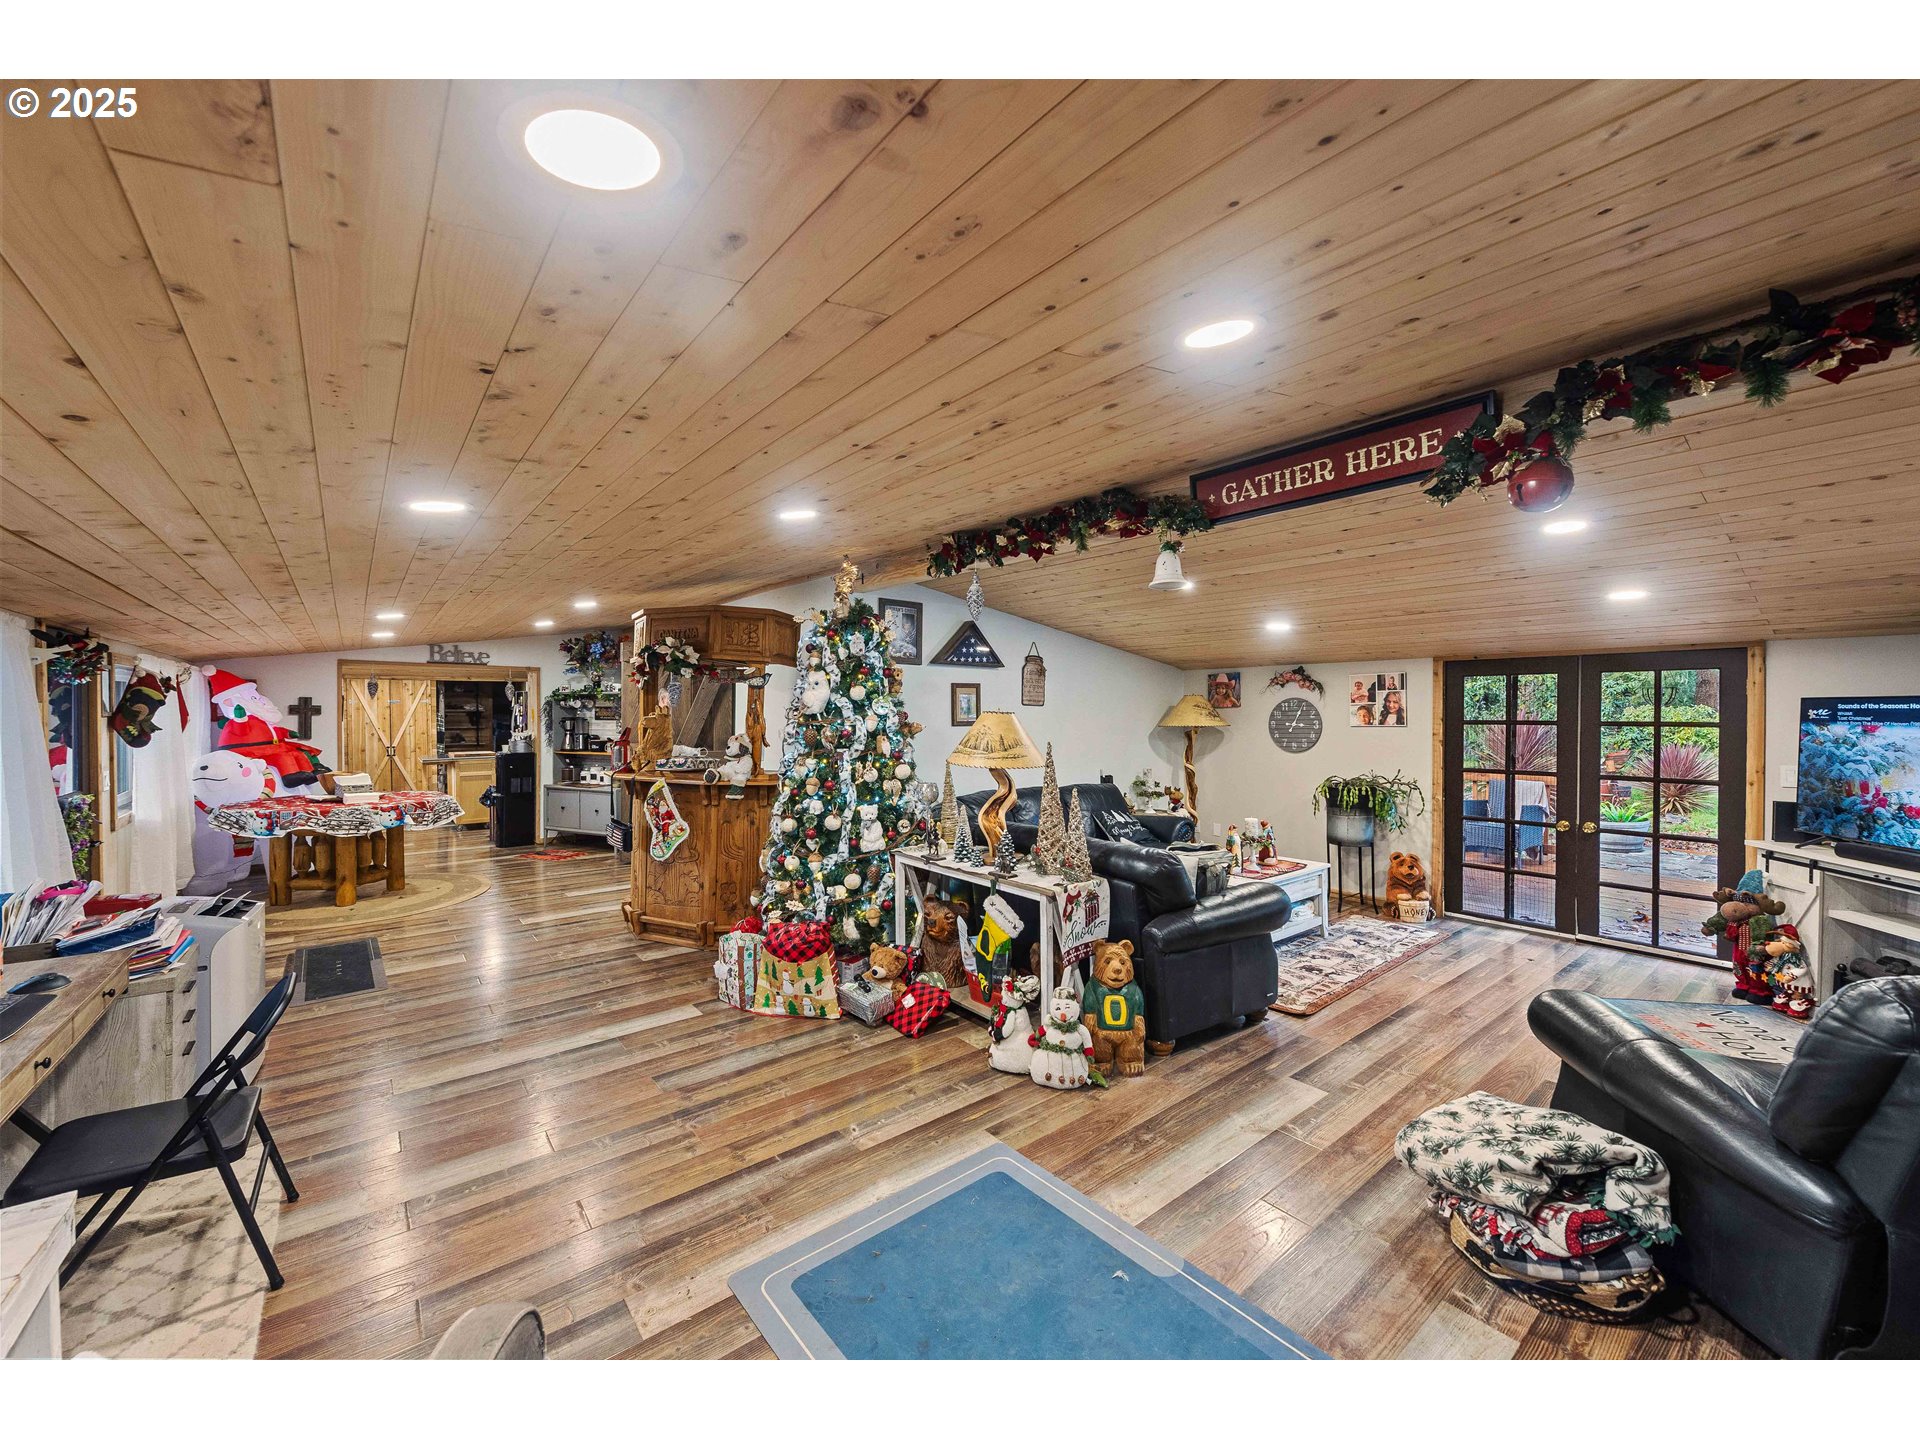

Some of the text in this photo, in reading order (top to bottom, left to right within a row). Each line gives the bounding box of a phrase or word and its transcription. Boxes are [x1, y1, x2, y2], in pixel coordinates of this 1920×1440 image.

[1221, 427, 1444, 505] GATHER HERE
[429, 643, 491, 664] Believe
[1281, 703, 1288, 711] 11
[1290, 700, 1298, 708] 12
[1274, 710, 1281, 718] 10
[1310, 710, 1315, 718] 2
[1313, 720, 1319, 729] 3
[1302, 739, 1307, 747] 5
[1064, 920, 1107, 949] Snow
[1103, 994, 1128, 1026] O
